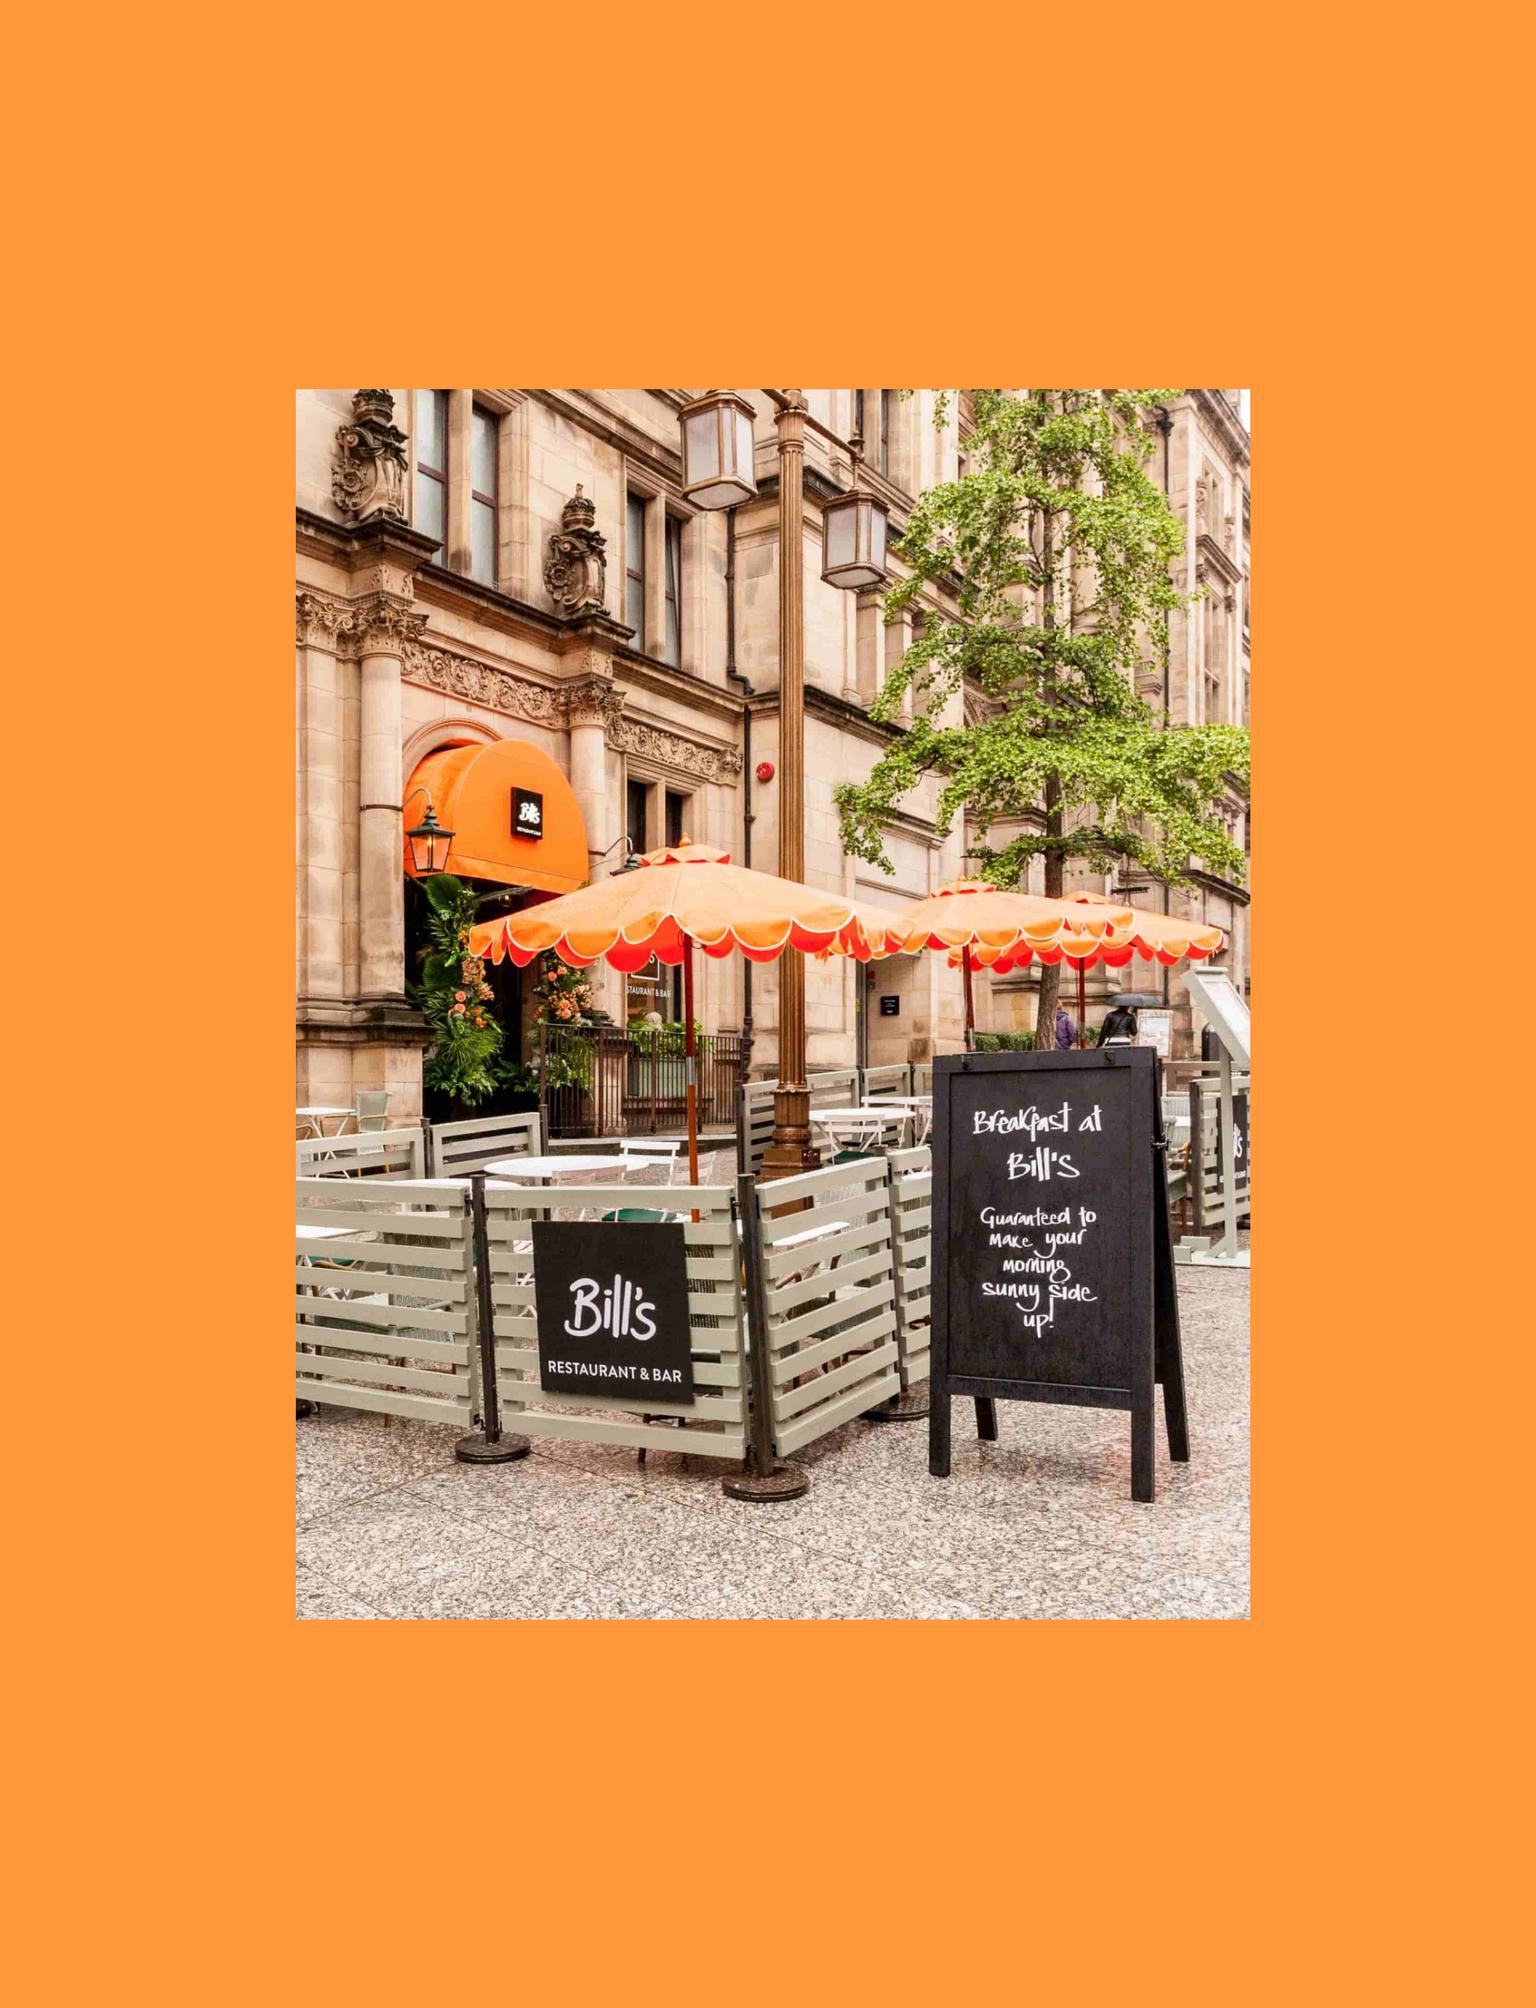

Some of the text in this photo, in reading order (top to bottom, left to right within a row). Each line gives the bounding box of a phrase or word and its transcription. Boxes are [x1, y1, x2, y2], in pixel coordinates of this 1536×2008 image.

[626, 985, 655, 996] STAURANT
[972, 1101, 1103, 1142] Breakfast at
[980, 1206, 1097, 1229] Guaranteed to
[1033, 1229, 1087, 1259] your
[1002, 1258, 1071, 1284] morning
[564, 1273, 657, 1341] Bill's
[981, 1281, 1098, 1312] sunny side
[1023, 1296, 1054, 1338] up!
[548, 1360, 682, 1383] RESTAURANT & BAR
